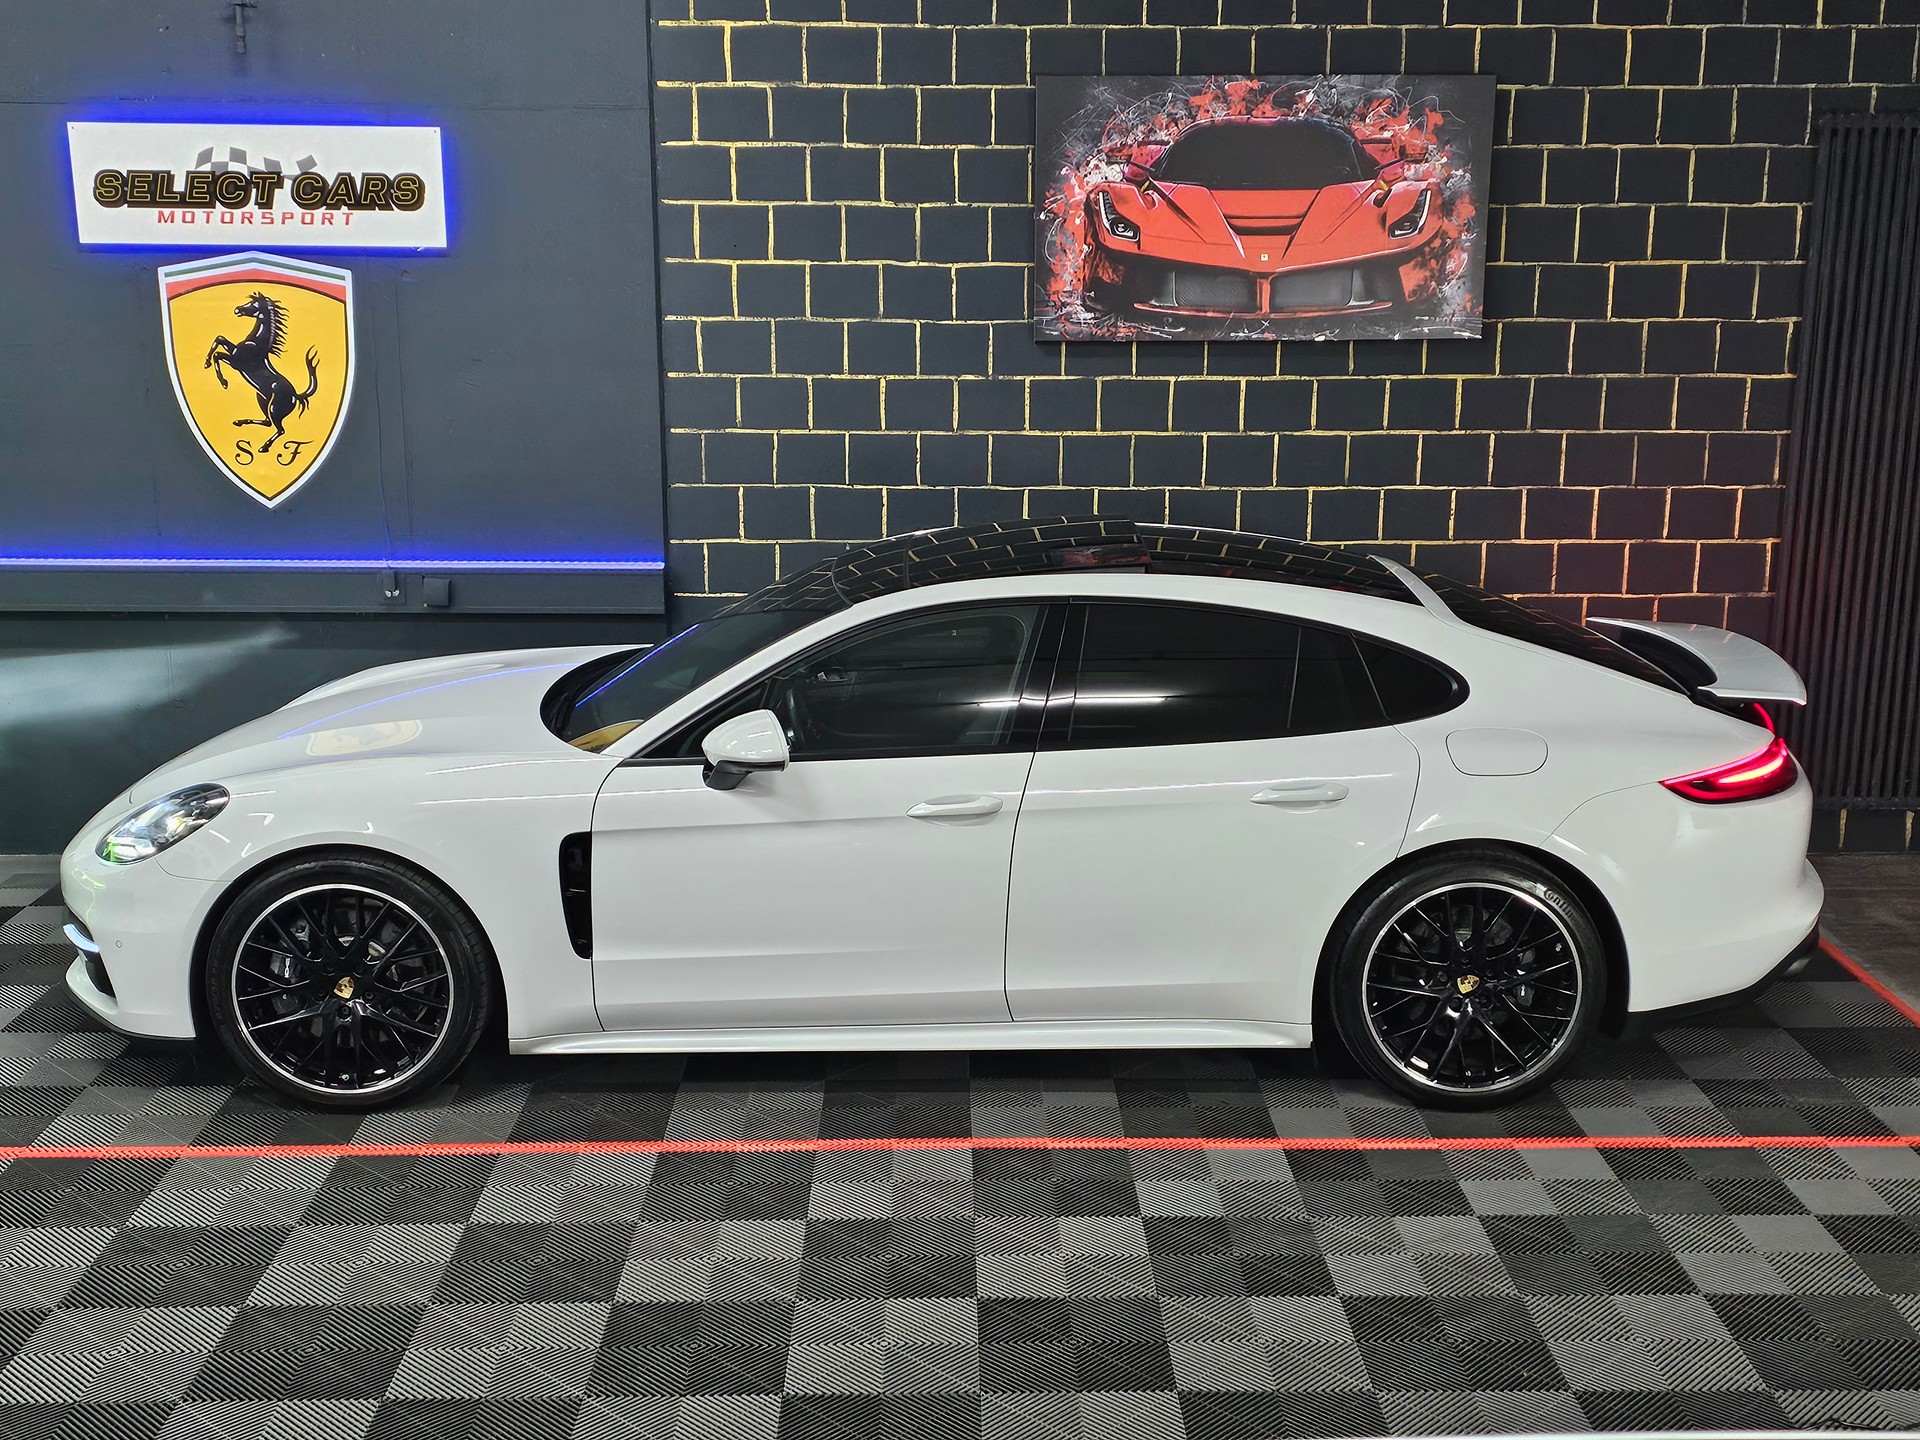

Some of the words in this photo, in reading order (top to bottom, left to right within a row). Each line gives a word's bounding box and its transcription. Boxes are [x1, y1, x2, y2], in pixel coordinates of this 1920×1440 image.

[93, 169, 284, 209] SELECT
[291, 172, 425, 211] CARS
[157, 210, 353, 225] MOTORSPORT
[235, 439, 254, 466] S
[276, 440, 315, 466] F
